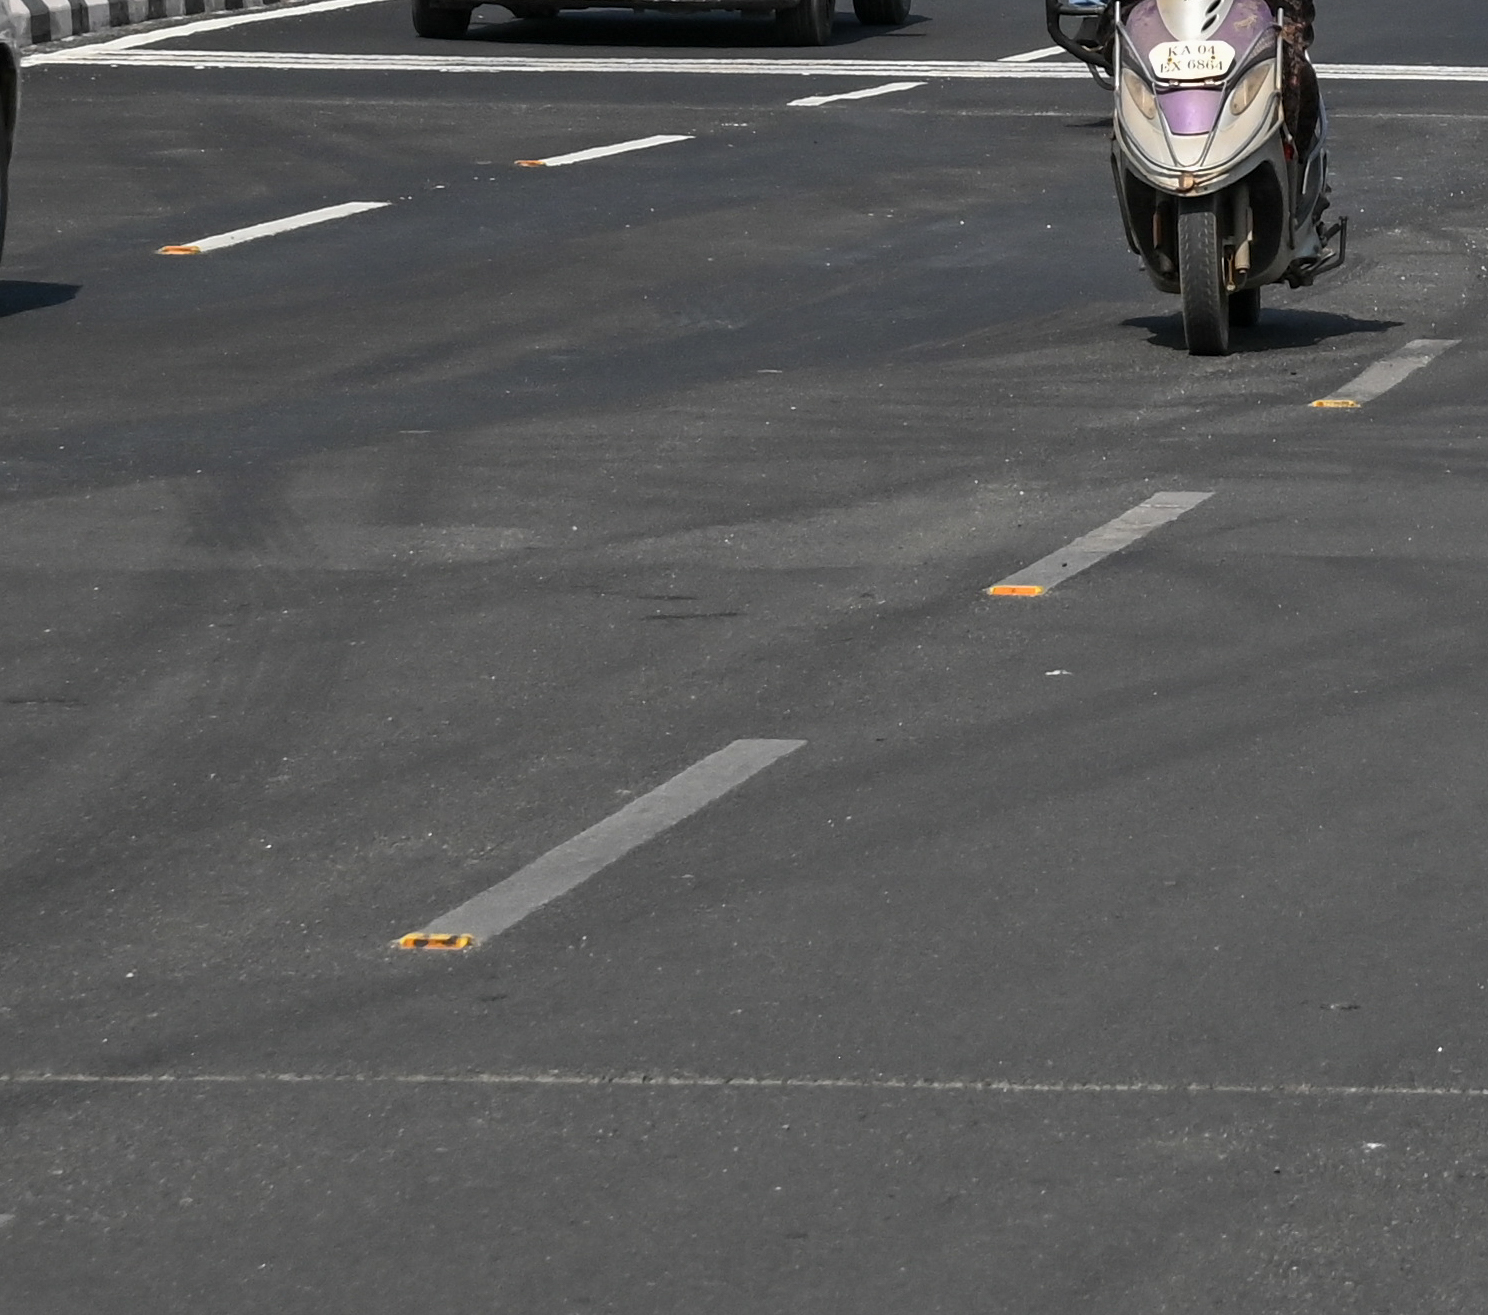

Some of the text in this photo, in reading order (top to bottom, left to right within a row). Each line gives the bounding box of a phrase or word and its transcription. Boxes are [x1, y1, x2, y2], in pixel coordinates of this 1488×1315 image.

[1168, 45, 1215, 57] KA 04
[1187, 60, 1222, 71] 6864
